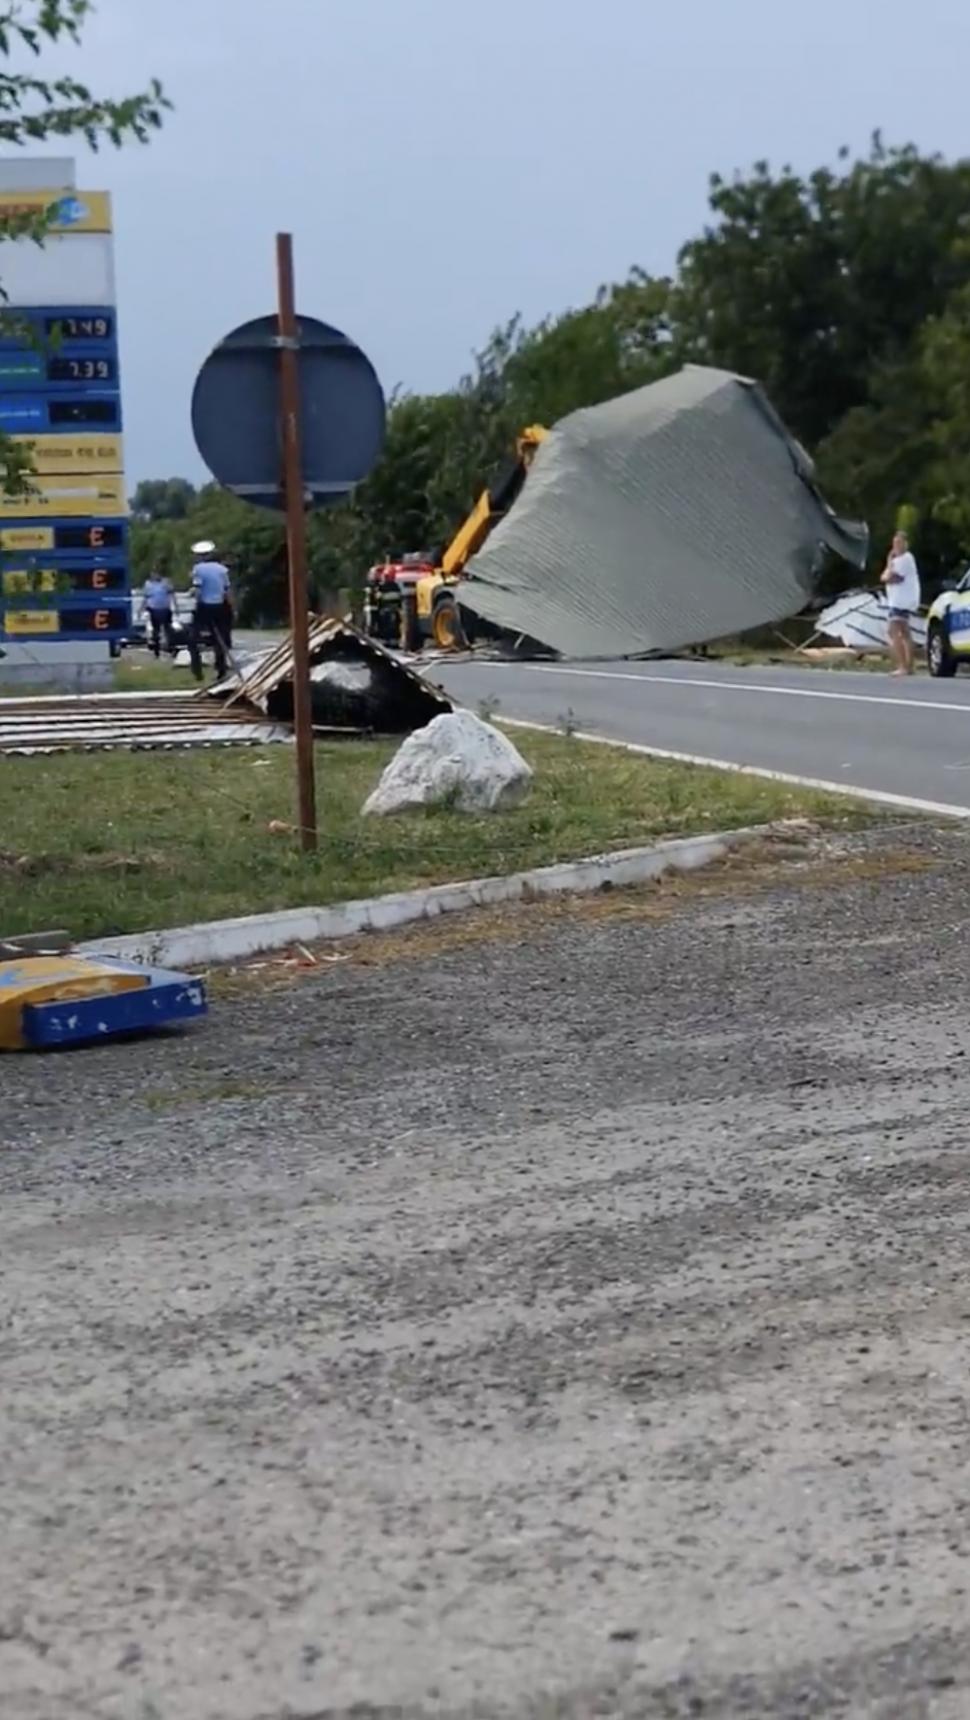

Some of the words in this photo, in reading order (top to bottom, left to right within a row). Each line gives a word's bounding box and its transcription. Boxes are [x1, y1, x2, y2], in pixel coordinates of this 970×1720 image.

[90, 526, 105, 546] E
[93, 569, 107, 588] E
[95, 610, 109, 629] E
